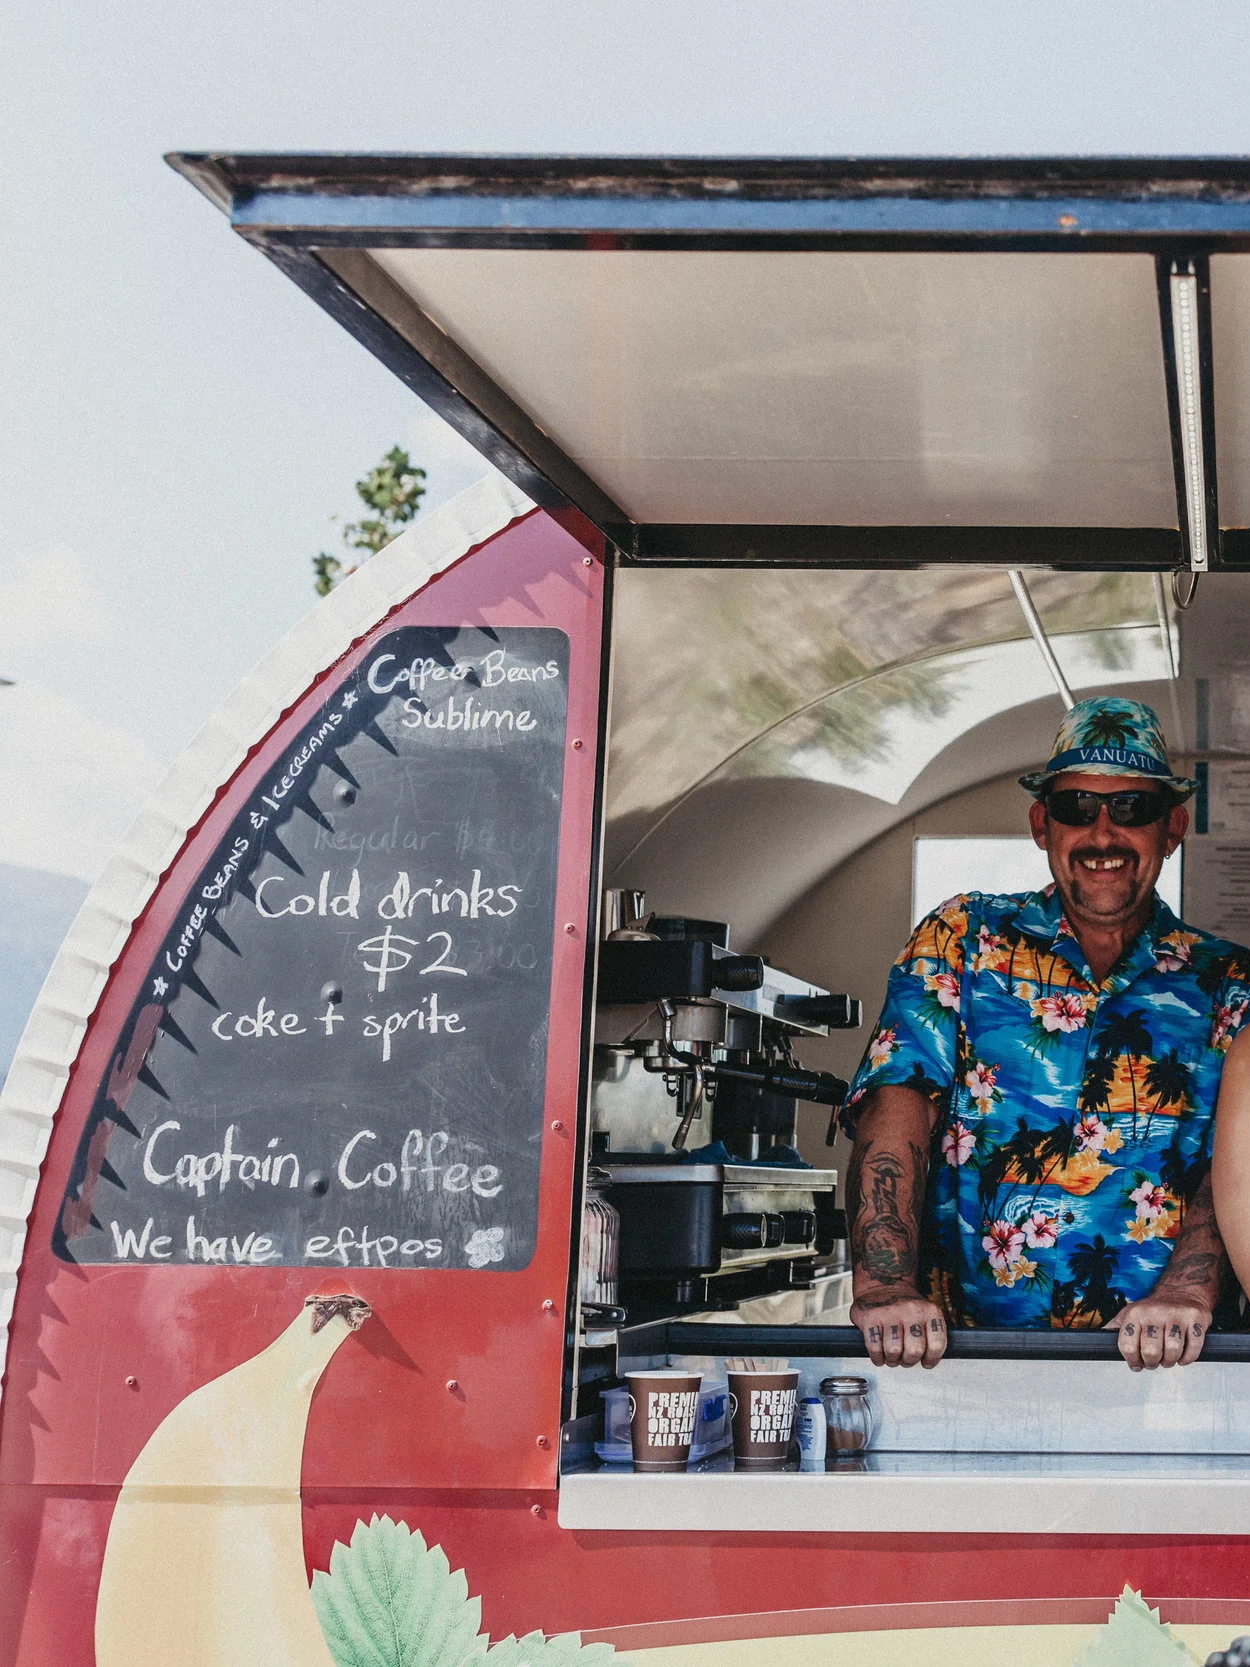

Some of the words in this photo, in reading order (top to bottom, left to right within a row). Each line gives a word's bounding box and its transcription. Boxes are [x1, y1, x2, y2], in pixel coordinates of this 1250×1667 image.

[367, 654, 475, 694] Coffee
[480, 649, 560, 687] Beans
[402, 696, 537, 731] Sublime
[1080, 749, 1155, 771] VANUATU
[202, 836, 250, 901] BEANS
[255, 868, 360, 919] Cold
[378, 868, 523, 919] drinks
[357, 925, 468, 992] $2
[211, 997, 307, 1041] coke
[363, 992, 466, 1062] sprite
[143, 1120, 300, 1197] Captain
[338, 1128, 503, 1197] Coffee
[110, 1217, 172, 1259] We
[186, 1214, 277, 1263] have
[305, 1224, 443, 1268] eftpos
[1123, 1322, 1203, 1340] SEAS
[648, 1406, 664, 1418] NZ
[750, 1404, 765, 1415] NZ
[648, 1433, 676, 1446] FAIR
[750, 1430, 777, 1442] FAIR
